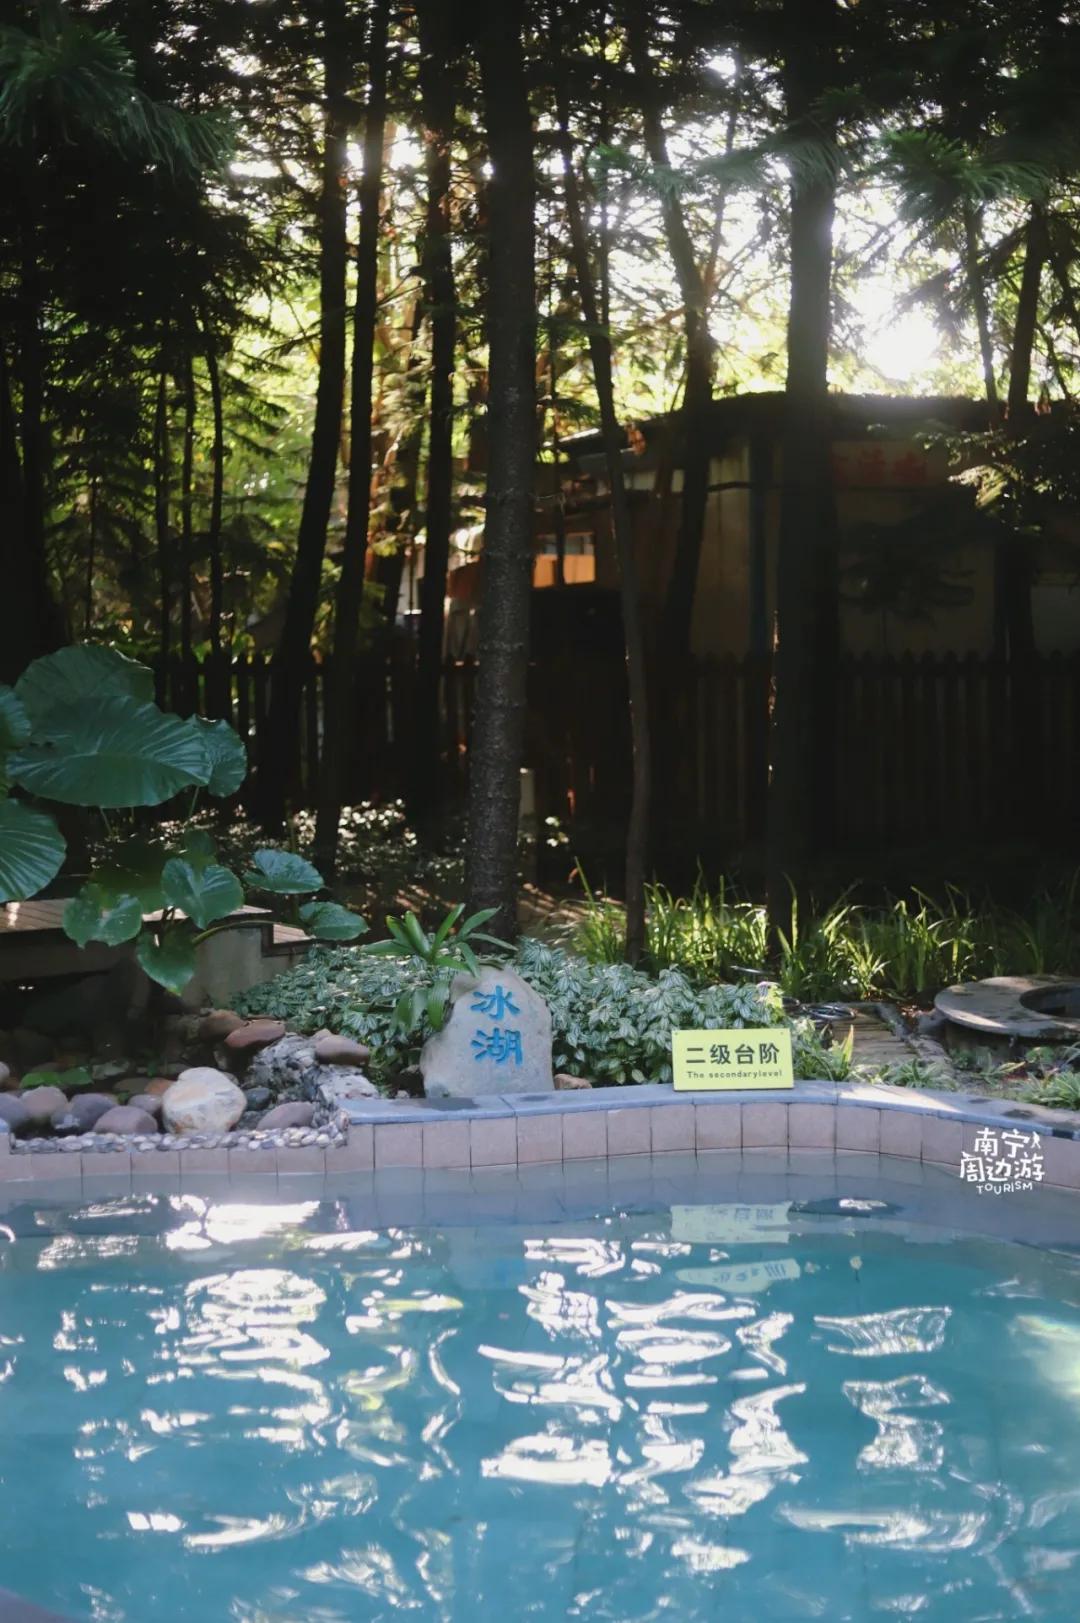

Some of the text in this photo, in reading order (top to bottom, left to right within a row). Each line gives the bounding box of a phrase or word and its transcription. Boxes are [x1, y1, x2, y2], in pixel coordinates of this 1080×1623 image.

[470, 985, 523, 1065] 冰湖
[686, 1043, 780, 1065] 二级台阶
